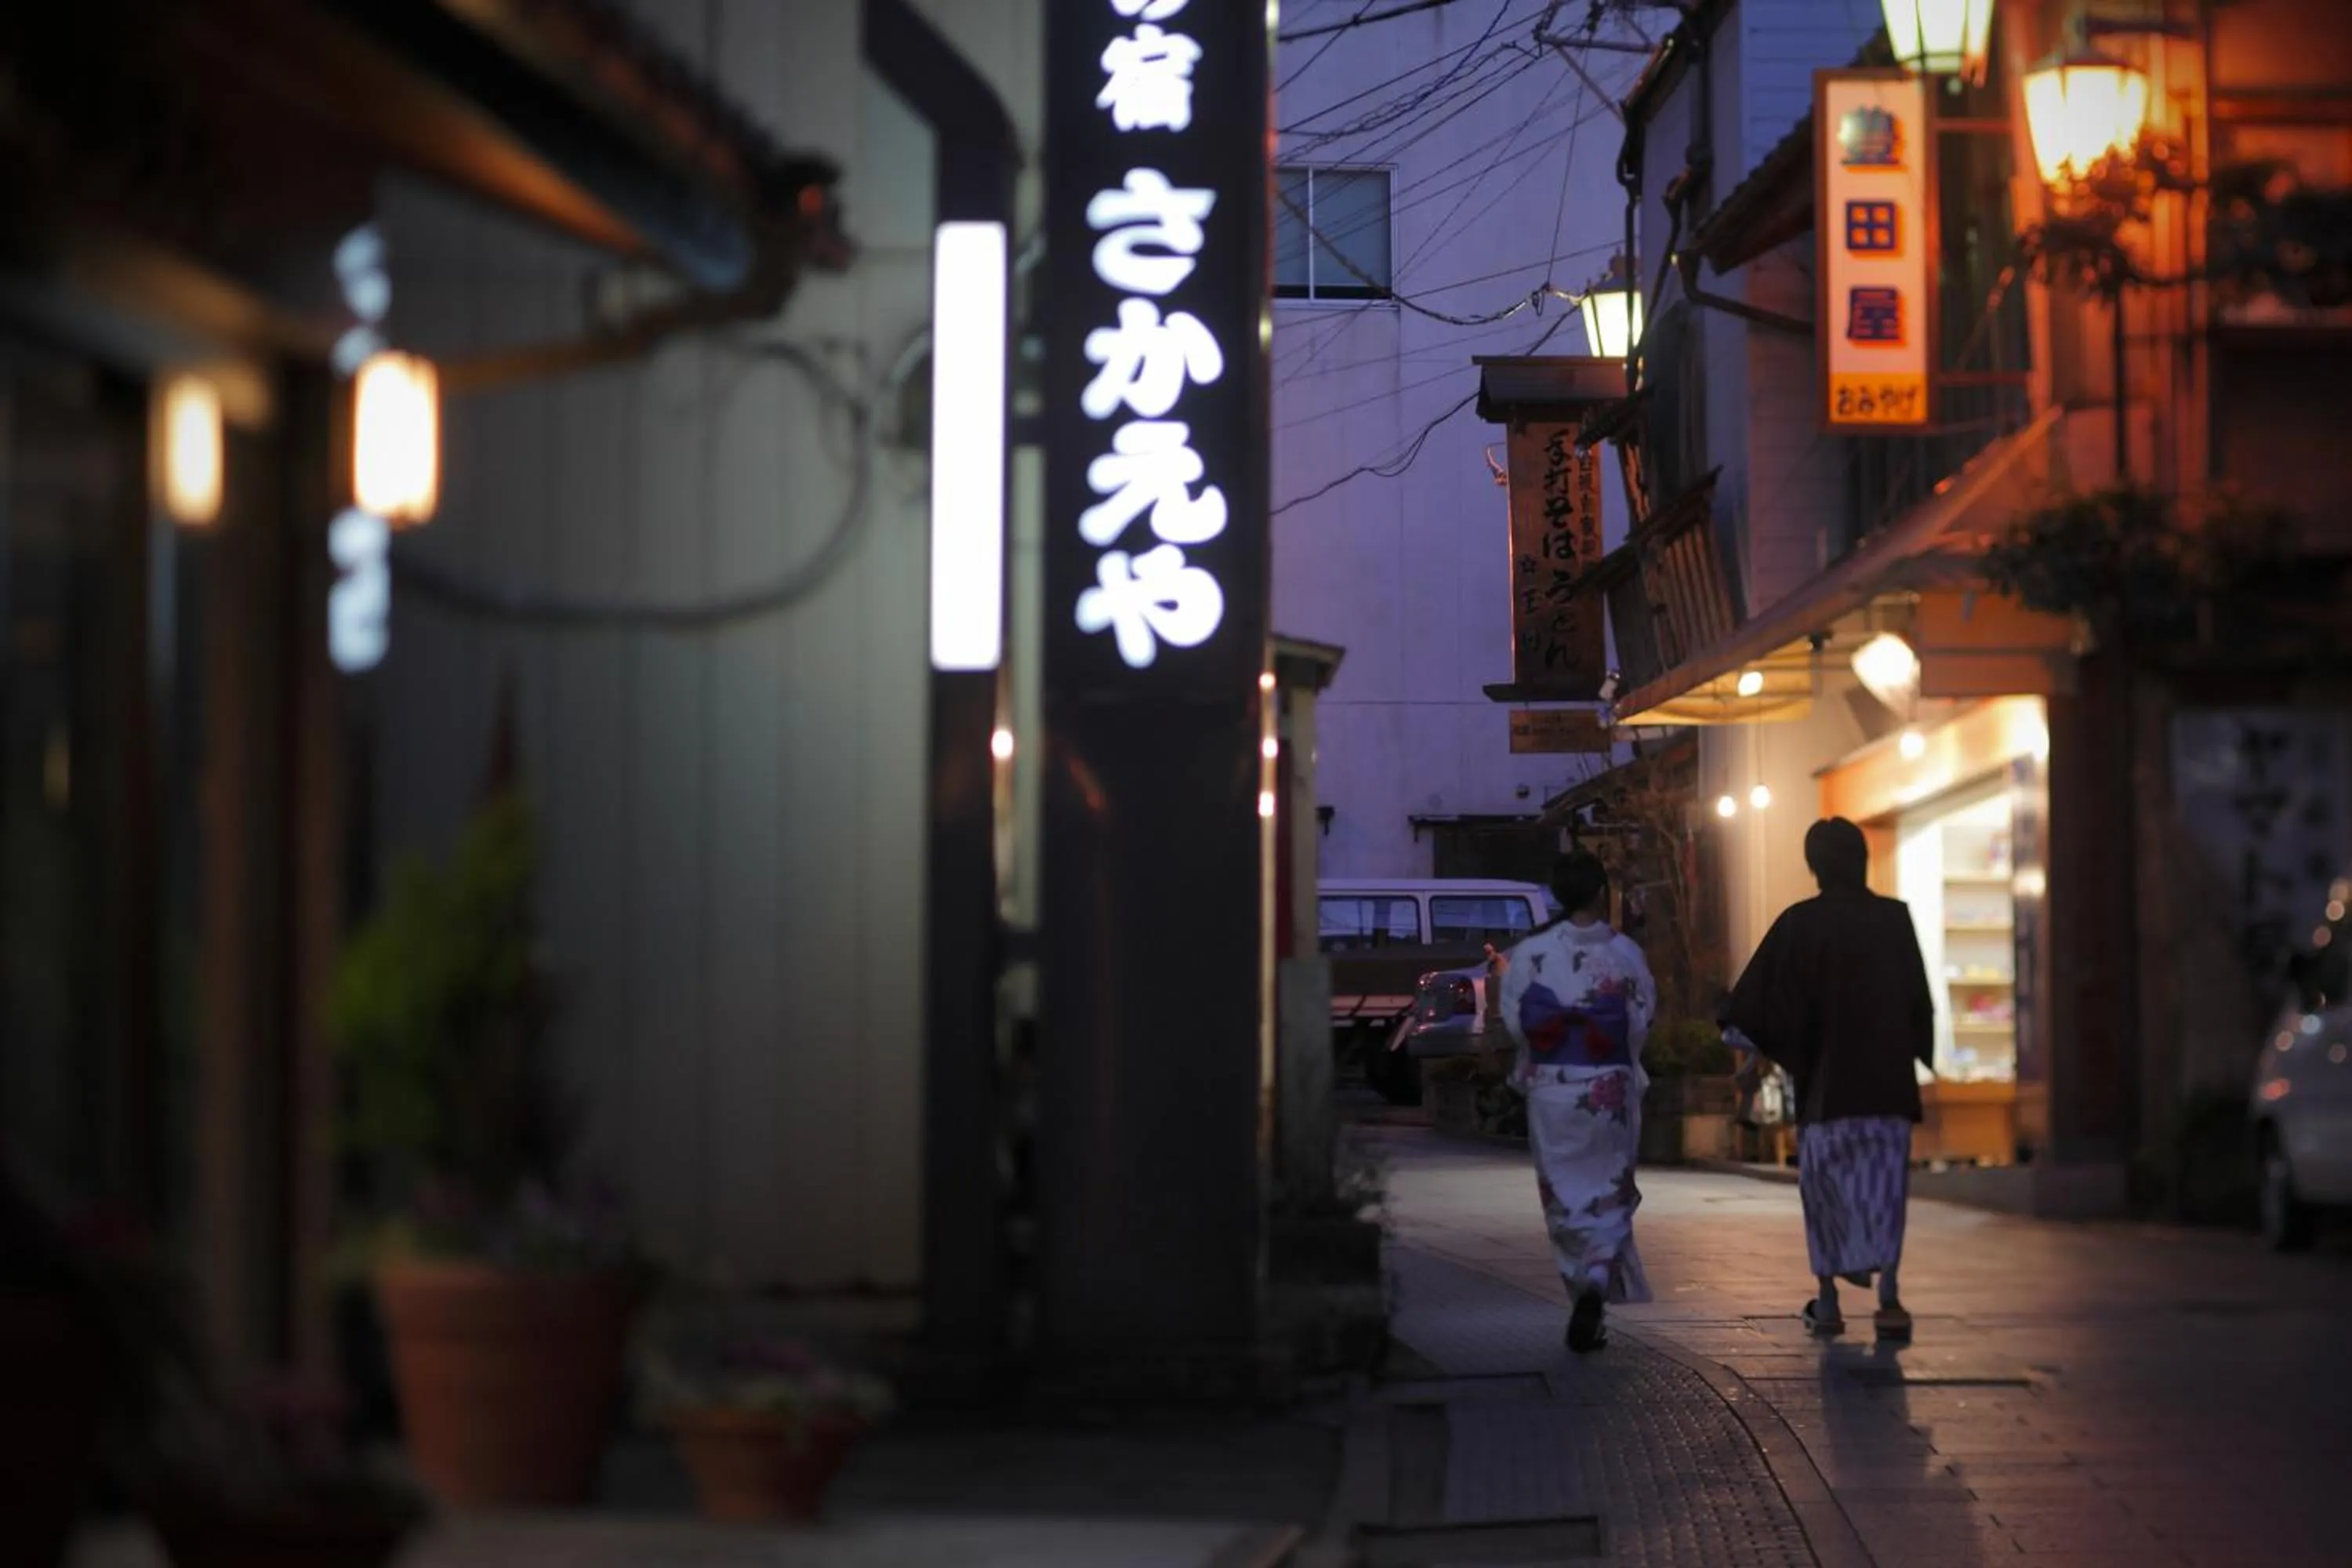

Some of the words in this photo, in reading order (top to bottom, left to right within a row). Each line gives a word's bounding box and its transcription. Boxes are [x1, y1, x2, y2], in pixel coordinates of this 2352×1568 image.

[1095, 0, 1203, 132] 宿
[1075, 166, 1228, 670] さかえや
